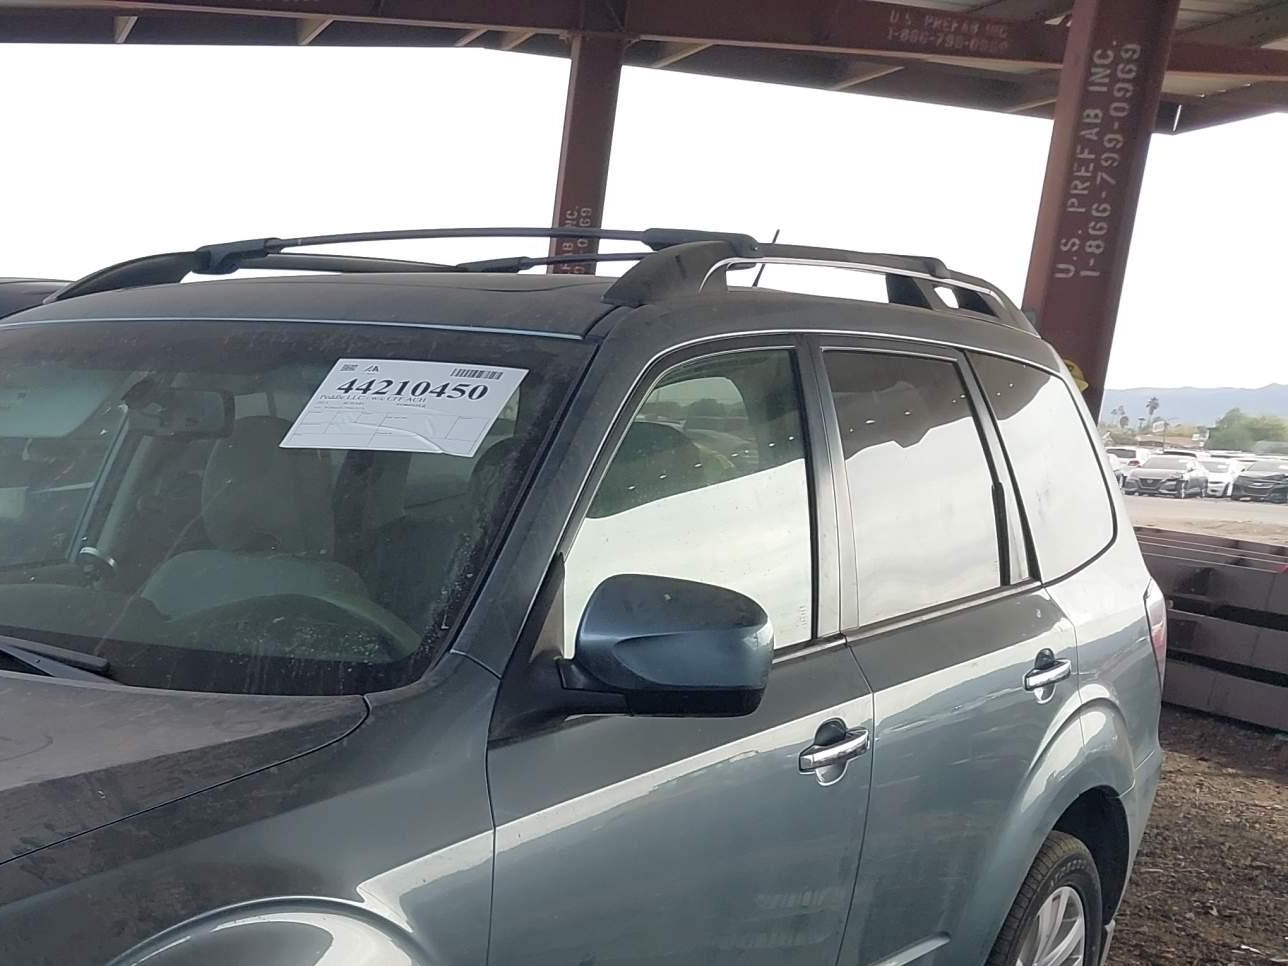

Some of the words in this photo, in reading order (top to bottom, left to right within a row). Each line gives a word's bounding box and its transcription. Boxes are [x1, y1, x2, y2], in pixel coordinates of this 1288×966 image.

[1088, 40, 1118, 93] INC.
[1066, 108, 1103, 213] PREFAB
[1079, 43, 1141, 278] 1-866-799-0969
[1054, 229, 1083, 279] U.S.
[336, 377, 489, 401] 44210450
